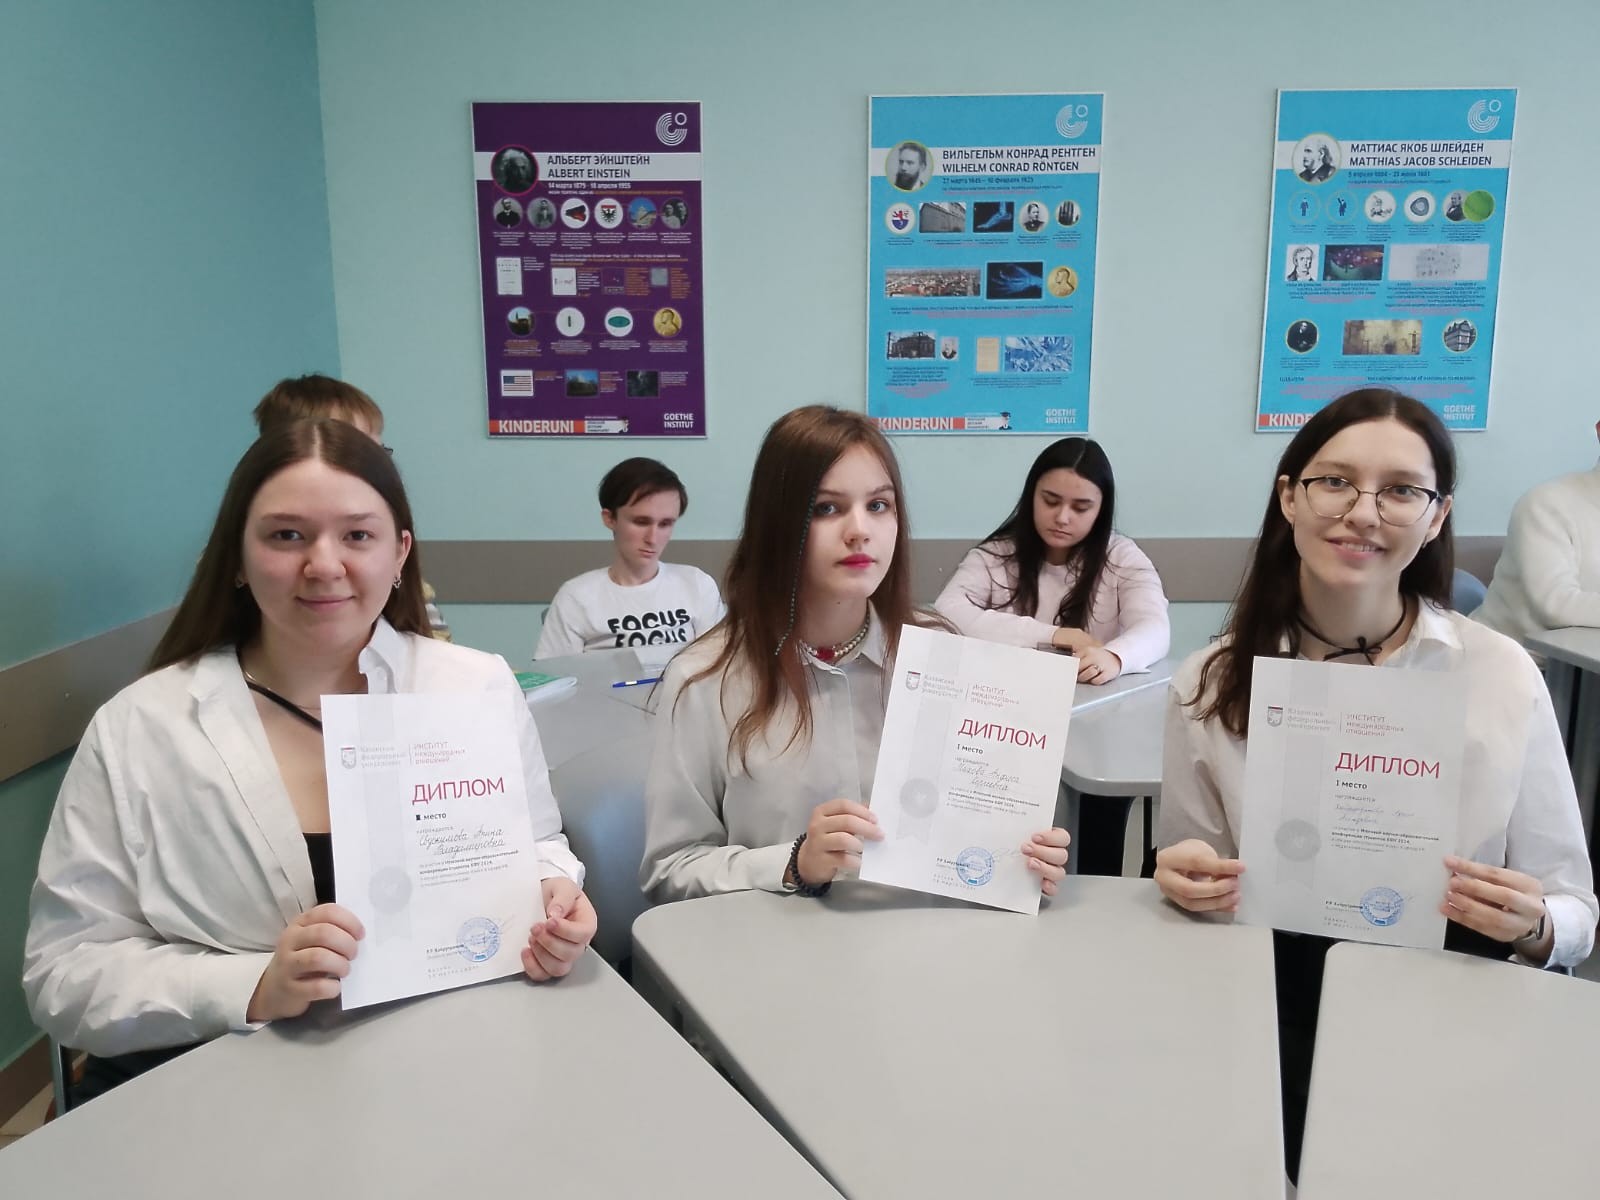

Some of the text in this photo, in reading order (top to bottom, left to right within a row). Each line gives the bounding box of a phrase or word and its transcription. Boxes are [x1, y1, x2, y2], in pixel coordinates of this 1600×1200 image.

[1350, 141, 1484, 154] МАТТИАС ЯКОБ ШЛЕЙДЕН
[942, 147, 1096, 160] ВИЛЬГЕЛЬМ КОНРАД РЕНТГЕН
[547, 153, 650, 165] АЛЬБЕРТ ЭЙНШТЕЙН
[1349, 156, 1492, 167] MATTHIAS JACOB SCHLEIDEN
[942, 161, 1079, 173] WILHELM CONRAD RÖNTGEN
[547, 168, 631, 178] ALBERT EINSTEIN
[1046, 408, 1077, 417] GOETHE
[1443, 404, 1476, 413] GOETHE
[663, 412, 694, 421] GOETHE
[1046, 416, 1076, 425] INSTITUT
[1443, 413, 1475, 421] INSTITUT
[498, 420, 574, 434] KINDERUNI
[663, 420, 694, 429] INSTITUT
[878, 417, 954, 431] KINDERUNI
[607, 608, 691, 634] FOCUS
[1346, 714, 1385, 722] ИНСТИТУТ
[957, 718, 1047, 751] ДИПЛОМ
[961, 746, 984, 755] место
[1334, 752, 1440, 780] ДИПЛОМ
[1341, 780, 1368, 790] место
[411, 776, 505, 806] ДИПЛОМ
[423, 812, 448, 821] место
